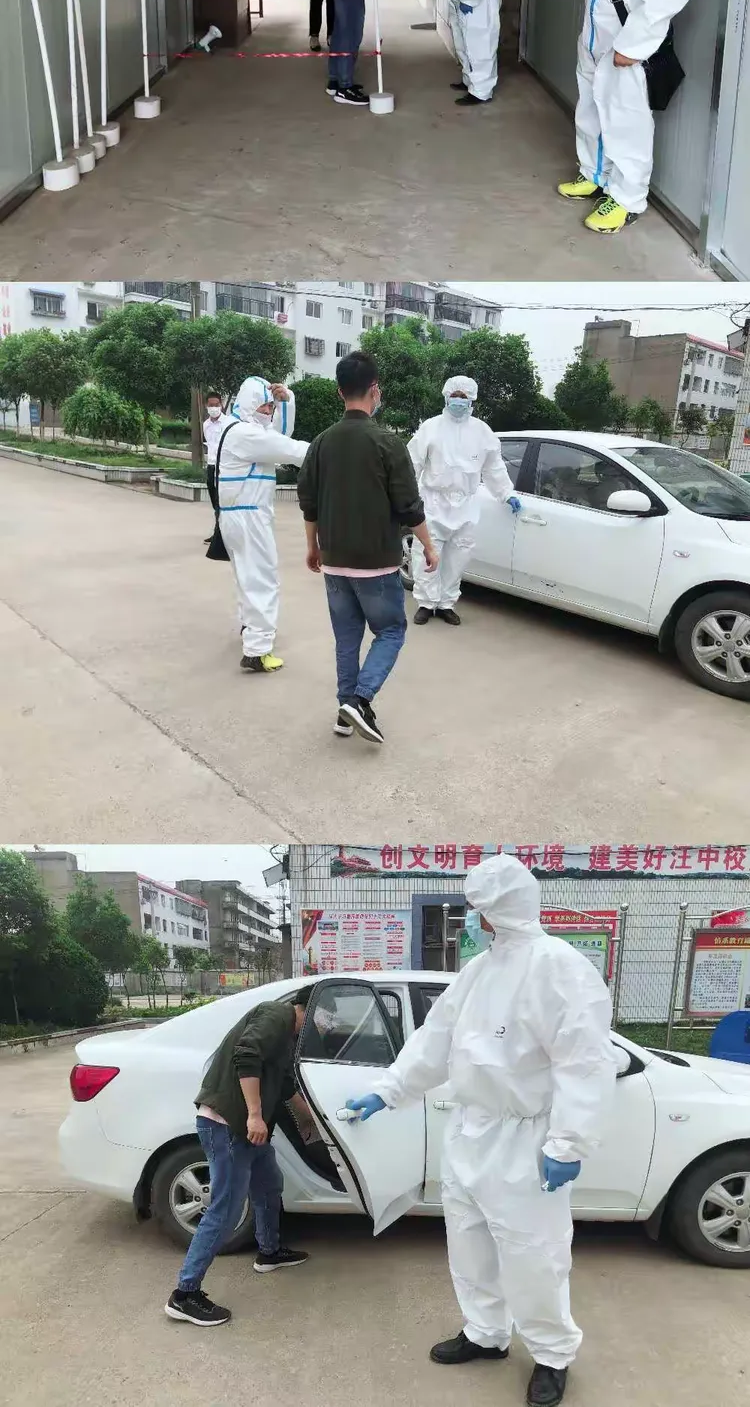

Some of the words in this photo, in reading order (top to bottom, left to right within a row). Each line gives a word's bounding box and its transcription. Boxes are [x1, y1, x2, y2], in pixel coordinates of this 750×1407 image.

[380, 843, 565, 871] 创文明育环境
